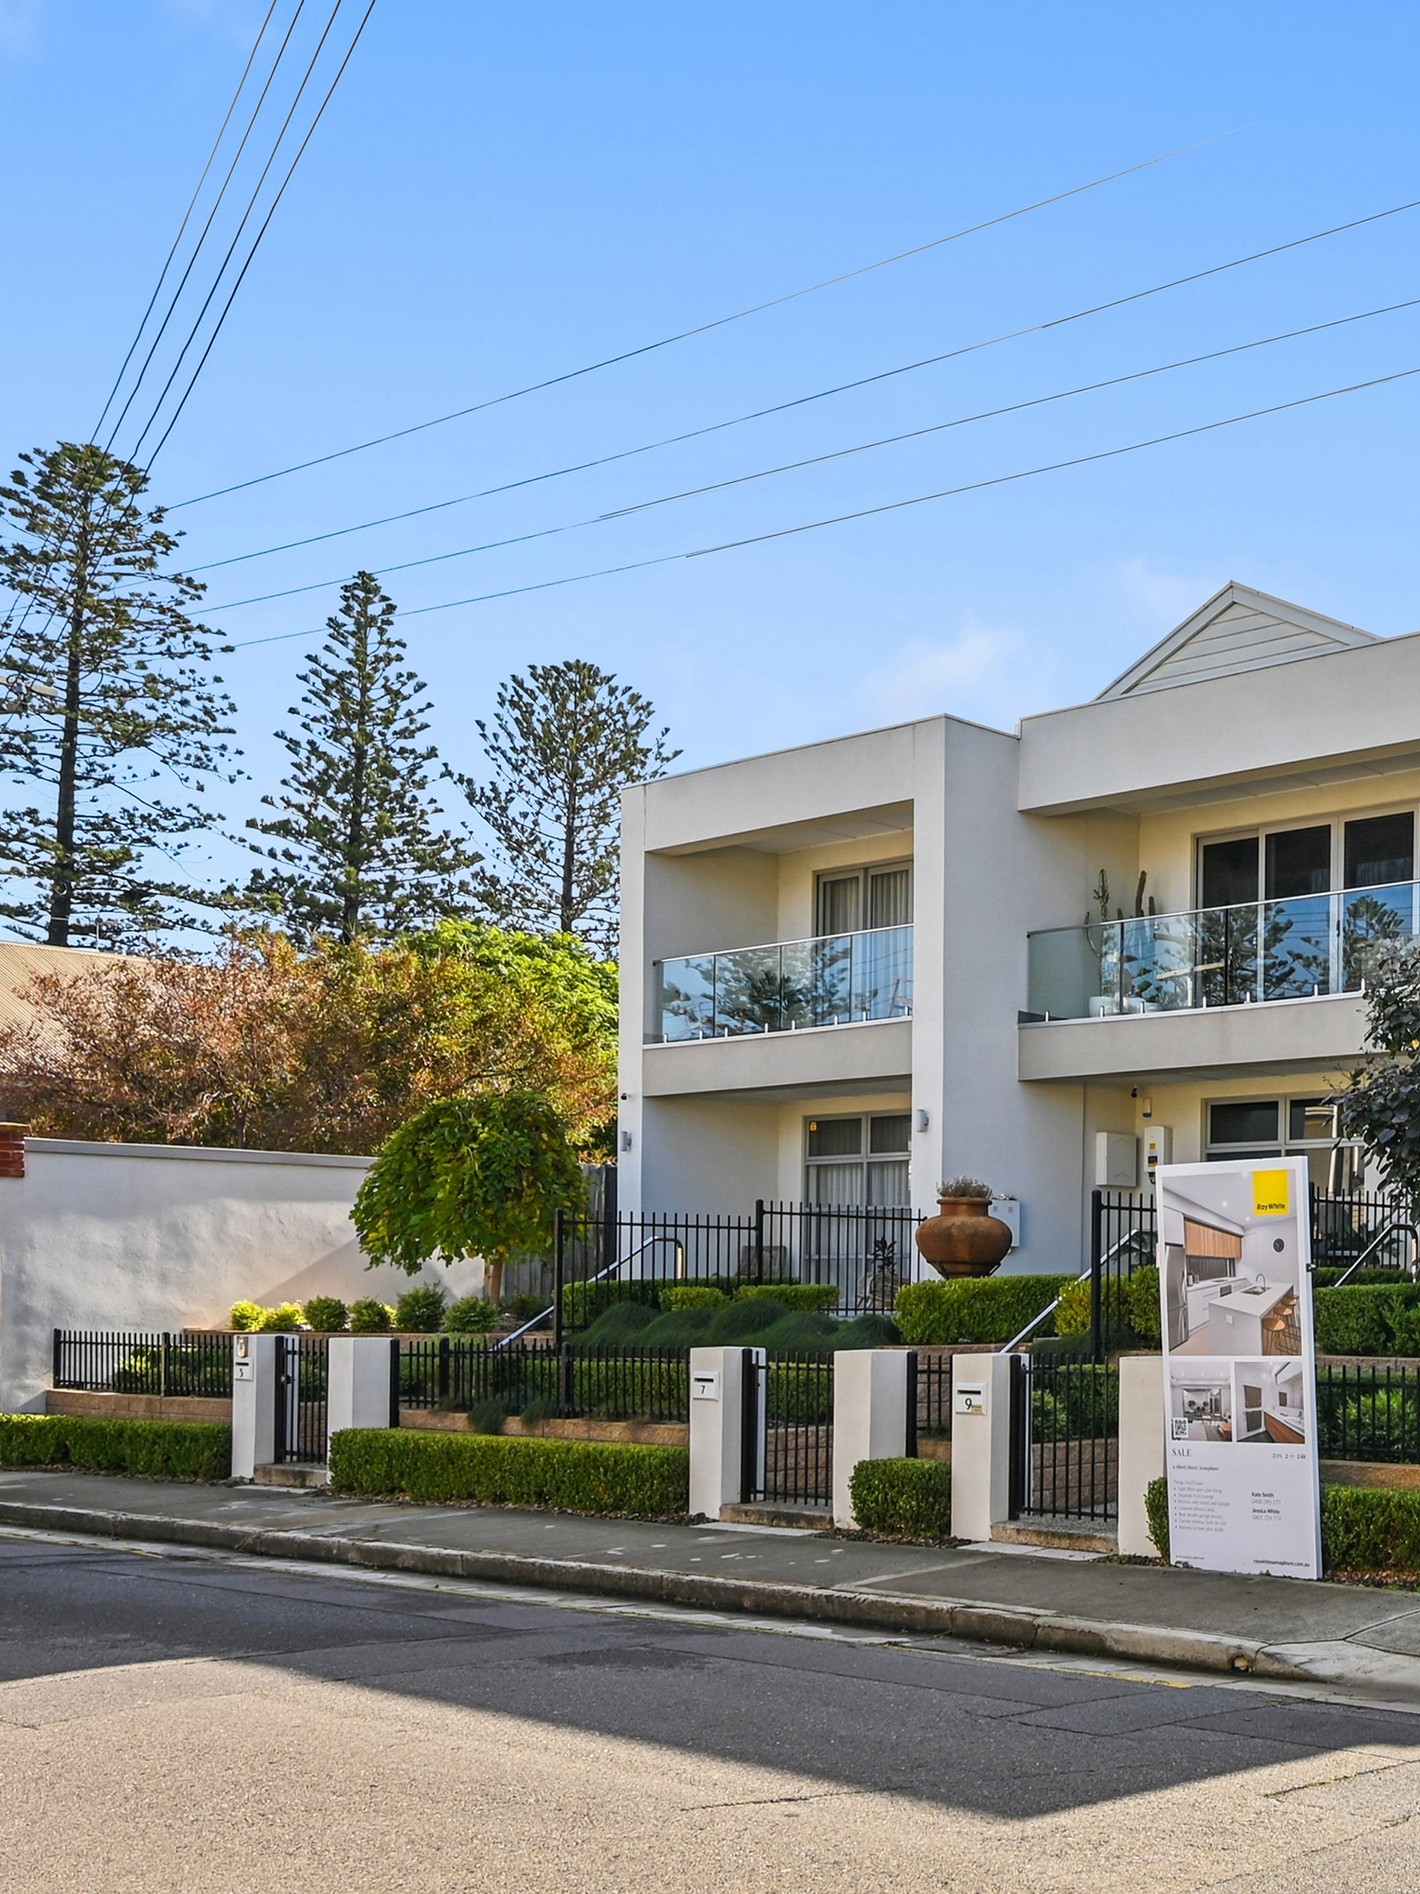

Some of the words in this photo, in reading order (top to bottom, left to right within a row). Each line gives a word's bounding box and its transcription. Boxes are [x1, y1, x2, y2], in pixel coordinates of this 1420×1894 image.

[700, 1385, 706, 1394] 7
[965, 1398, 972, 1410] 9
[1172, 1448, 1191, 1457] SALE
